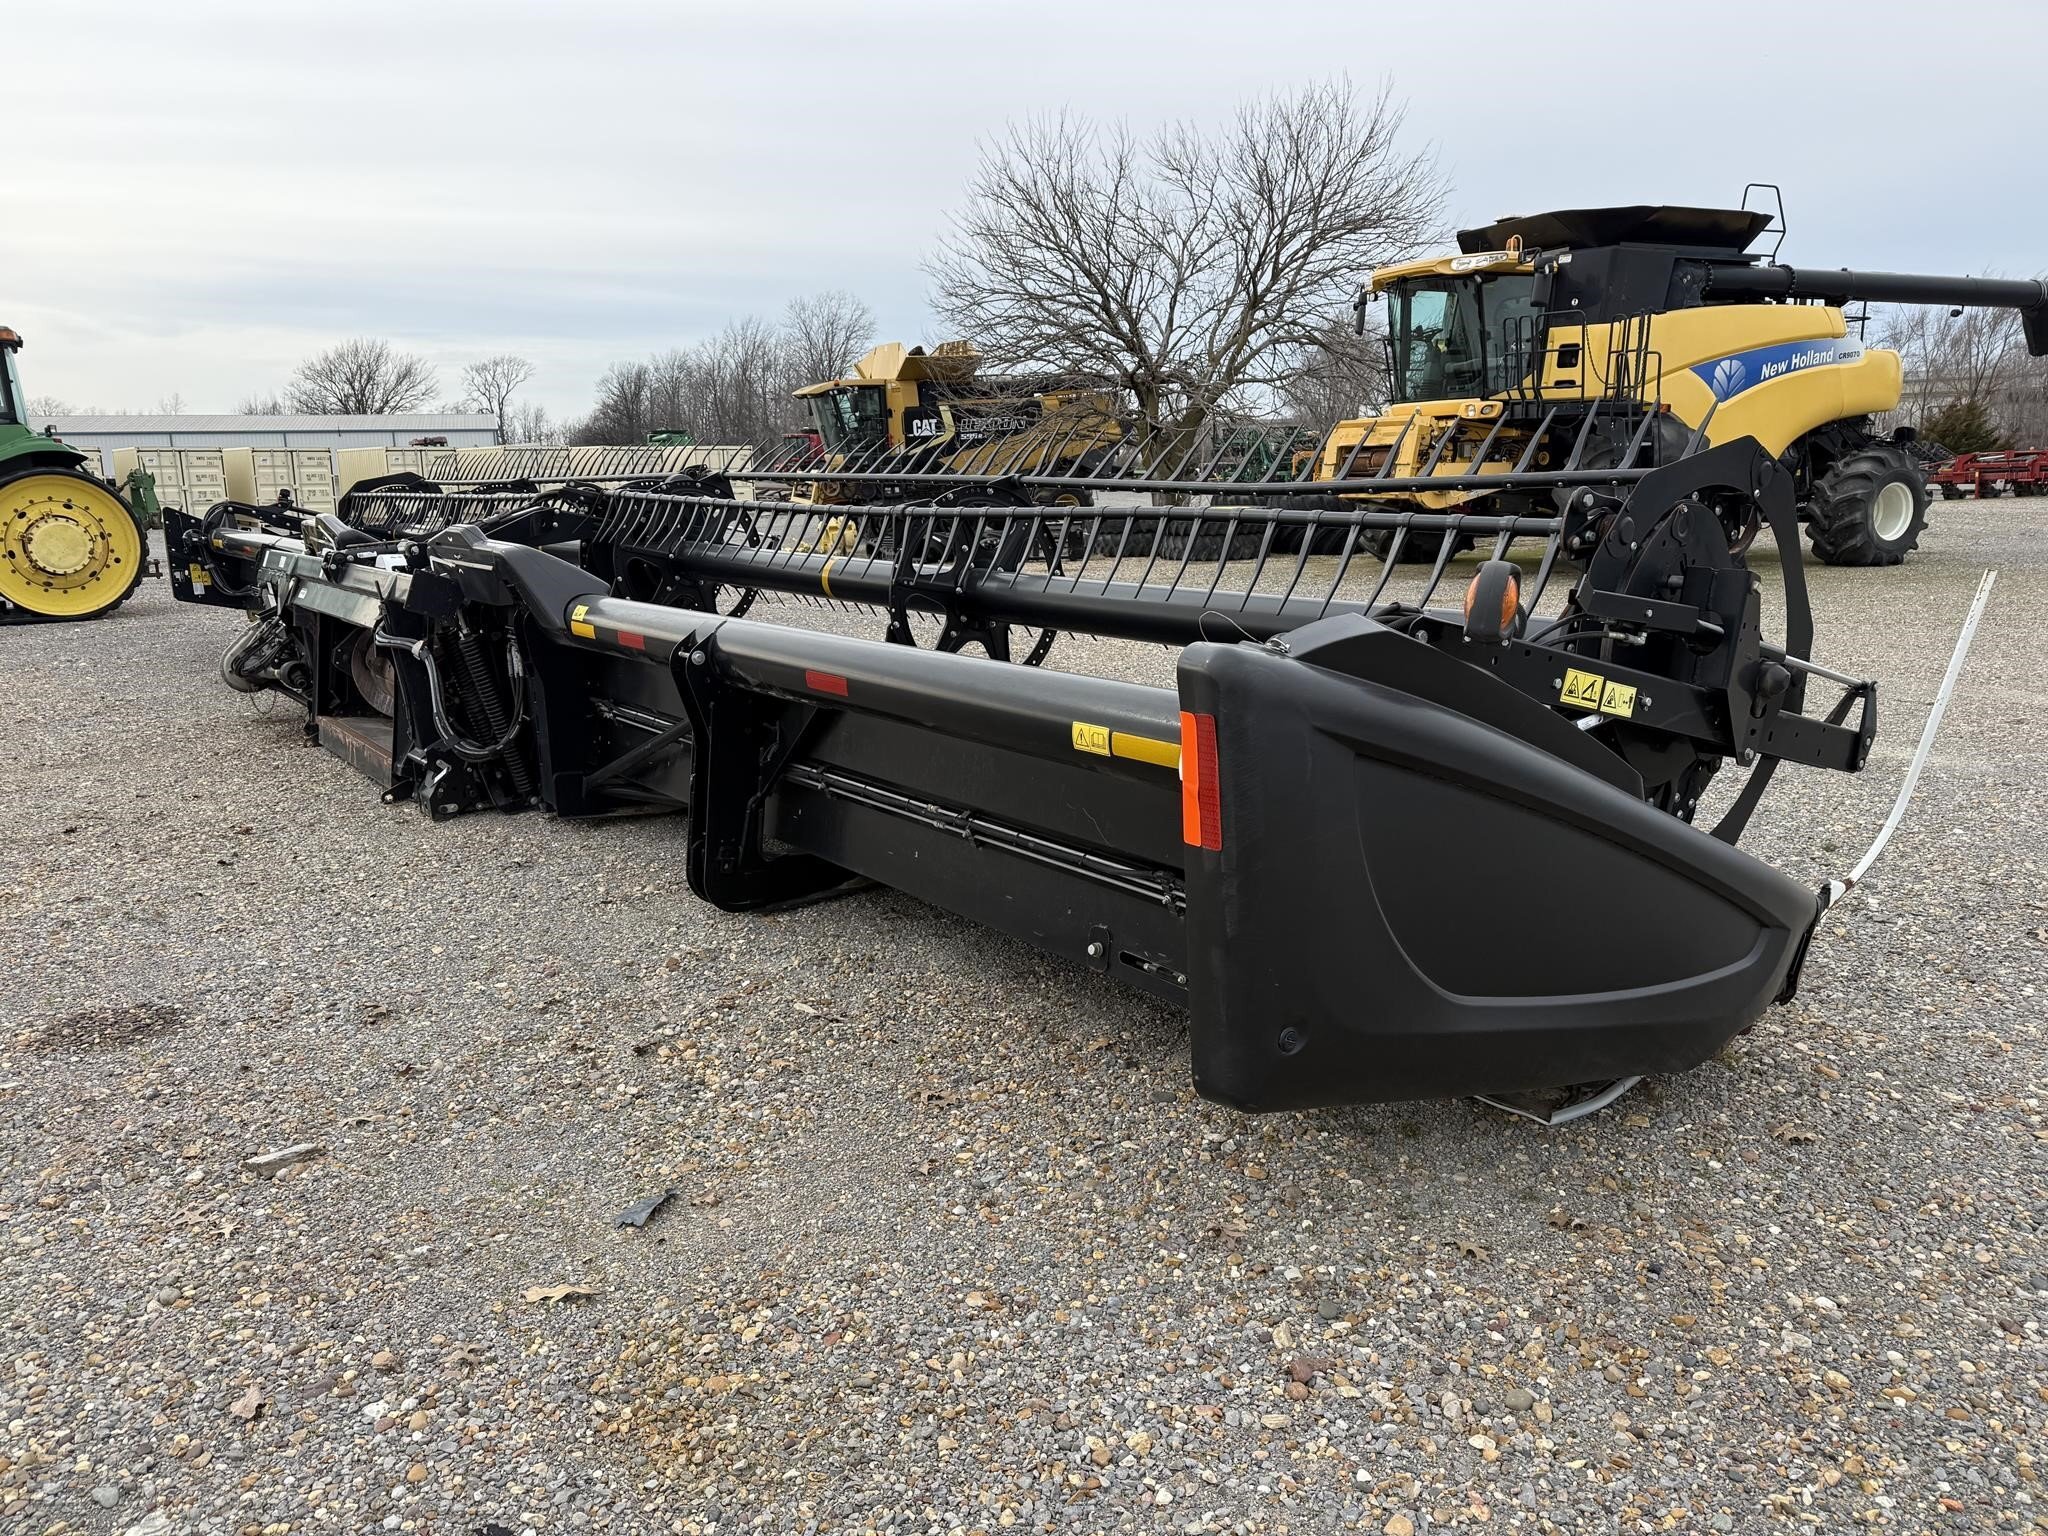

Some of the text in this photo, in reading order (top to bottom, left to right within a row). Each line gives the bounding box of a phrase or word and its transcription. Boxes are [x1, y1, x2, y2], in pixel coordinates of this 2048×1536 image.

[1760, 347, 1834, 381] New Holland
[1838, 351, 1861, 360] CR9070
[912, 418, 938, 437] CAT
[960, 416, 1026, 432] LEXION
